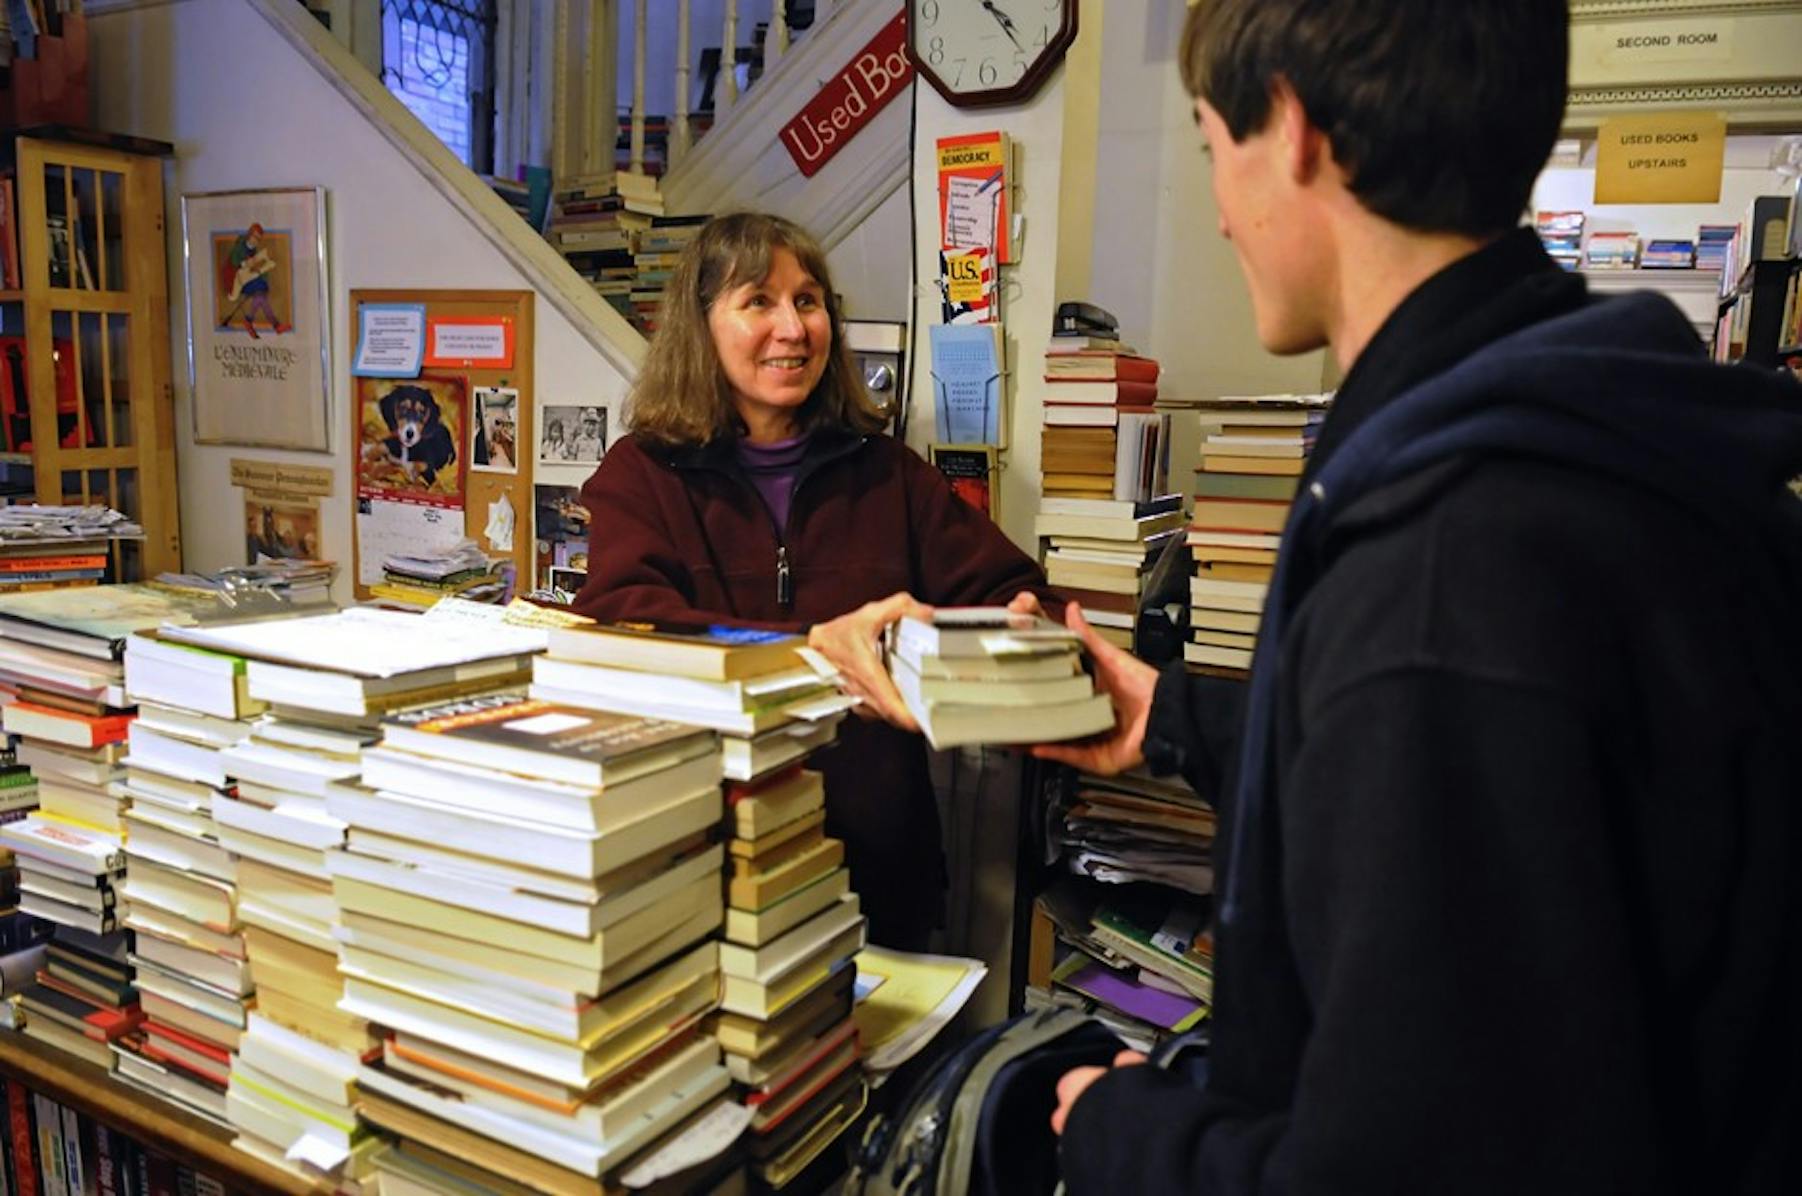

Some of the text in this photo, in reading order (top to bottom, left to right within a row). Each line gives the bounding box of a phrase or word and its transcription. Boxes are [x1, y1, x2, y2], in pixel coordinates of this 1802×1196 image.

[1033, 24, 1048, 46] 4
[1617, 33, 1717, 48] SECOND ROOM
[929, 36, 944, 65] 8
[952, 58, 966, 87] 7
[979, 57, 997, 86] 6
[789, 74, 868, 160] Used
[1621, 132, 1698, 144] USED BOOKS
[942, 151, 990, 166] DEMOCRACY
[1628, 158, 1687, 169] UPSTAIRS
[951, 261, 978, 280] U.S.
